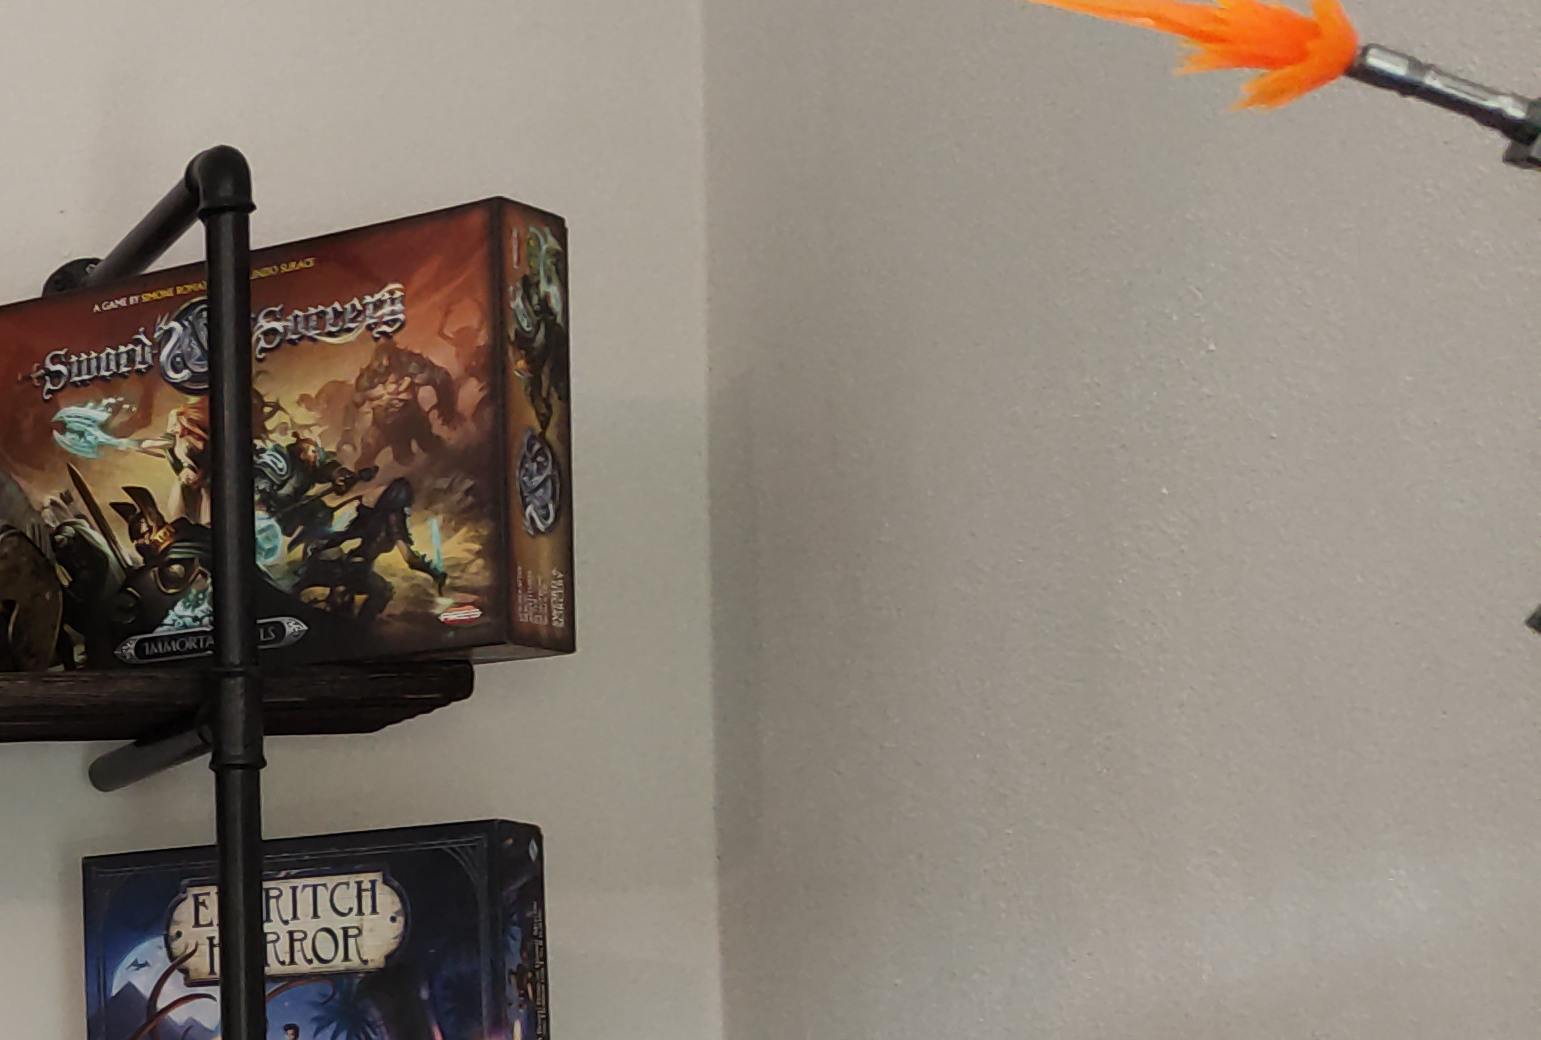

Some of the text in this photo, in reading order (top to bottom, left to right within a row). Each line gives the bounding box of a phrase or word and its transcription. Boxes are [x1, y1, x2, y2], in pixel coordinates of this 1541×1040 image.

[93, 303, 102, 313] A
[102, 297, 128, 311] GAME
[41, 327, 156, 400] Sword
[252, 282, 406, 361] Sorcery
[144, 635, 214, 656] IMMORTA
[191, 878, 380, 929] ERITCH
